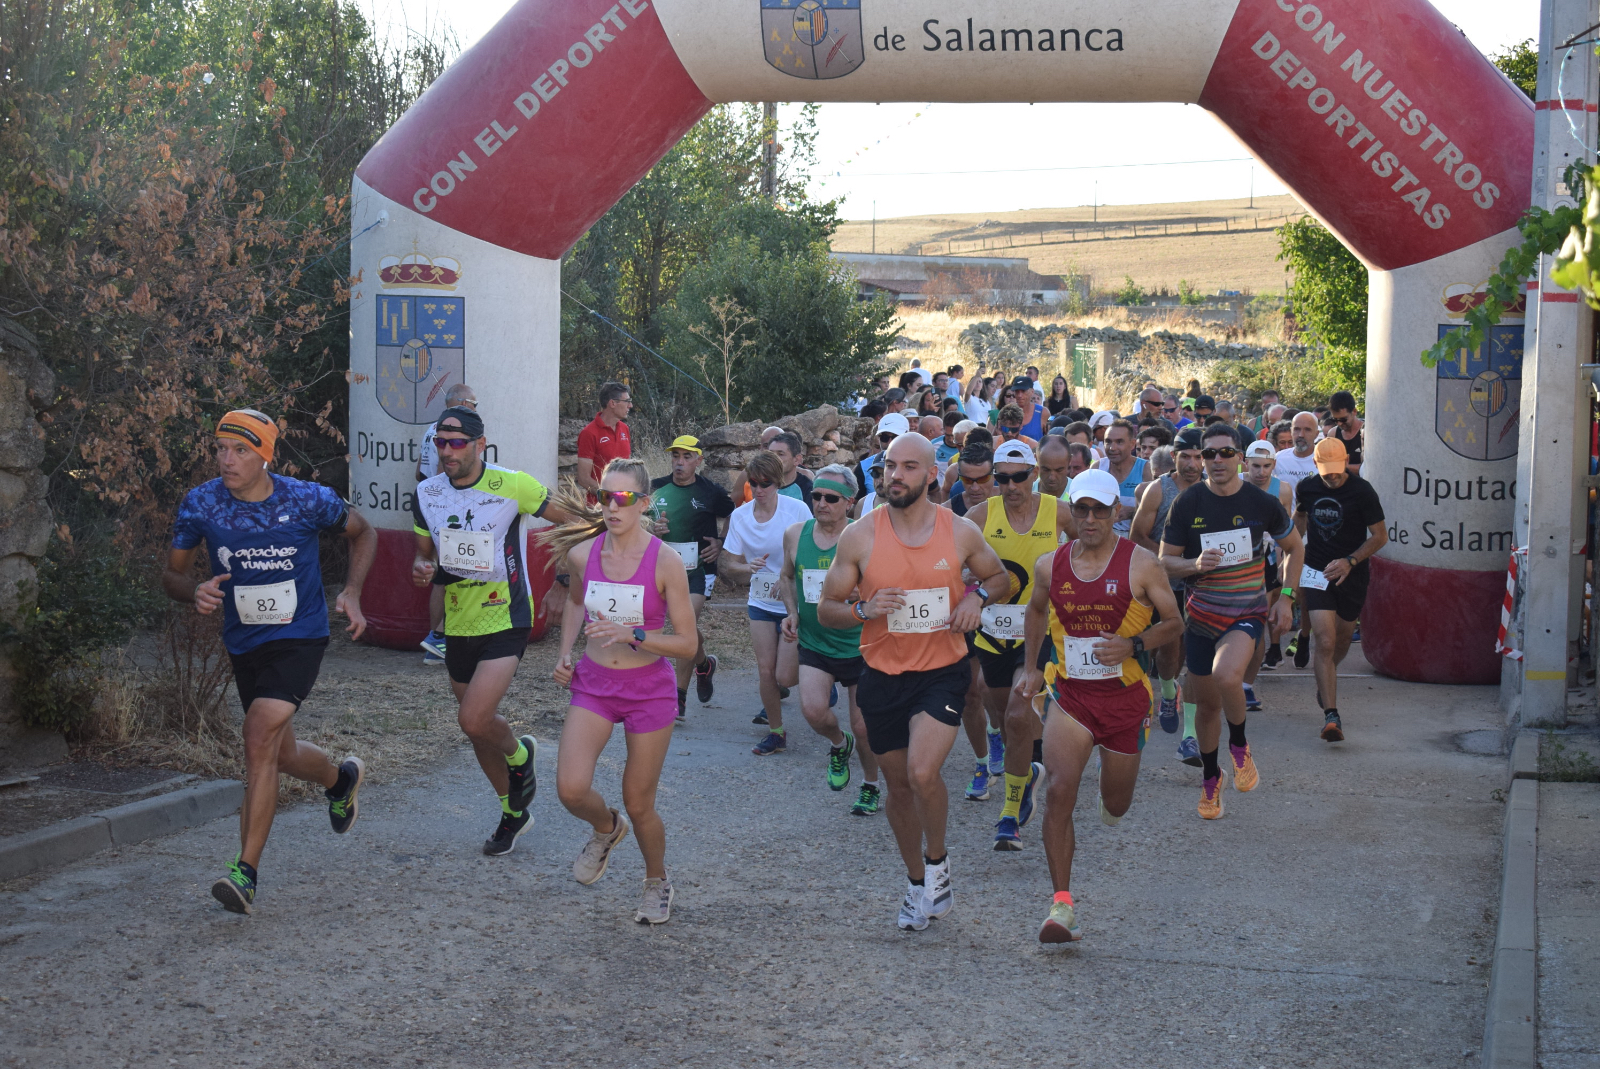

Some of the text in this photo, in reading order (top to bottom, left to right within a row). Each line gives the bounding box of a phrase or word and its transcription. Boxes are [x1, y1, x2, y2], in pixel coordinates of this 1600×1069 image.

[873, 18, 1124, 52] de Salamanca
[413, 0, 651, 213] CON EL DEPORTE
[1251, 31, 1450, 230] DEPORTISTAS
[1340, 49, 1500, 210] NUESTROS
[352, 484, 362, 506] de
[1388, 521, 1409, 545] de
[235, 545, 298, 560] apaches
[457, 543, 476, 556] 66
[1219, 542, 1236, 555] 50
[241, 559, 294, 570] running
[1306, 569, 1318, 579] 51
[256, 598, 278, 612] 82
[608, 598, 617, 613] 2
[909, 604, 929, 619] 16
[905, 617, 946, 630] gruponani
[994, 616, 1012, 627] 69
[1077, 614, 1101, 622] VINO
[1070, 623, 1111, 631] DE TORO
[1079, 665, 1118, 676] gruponani
